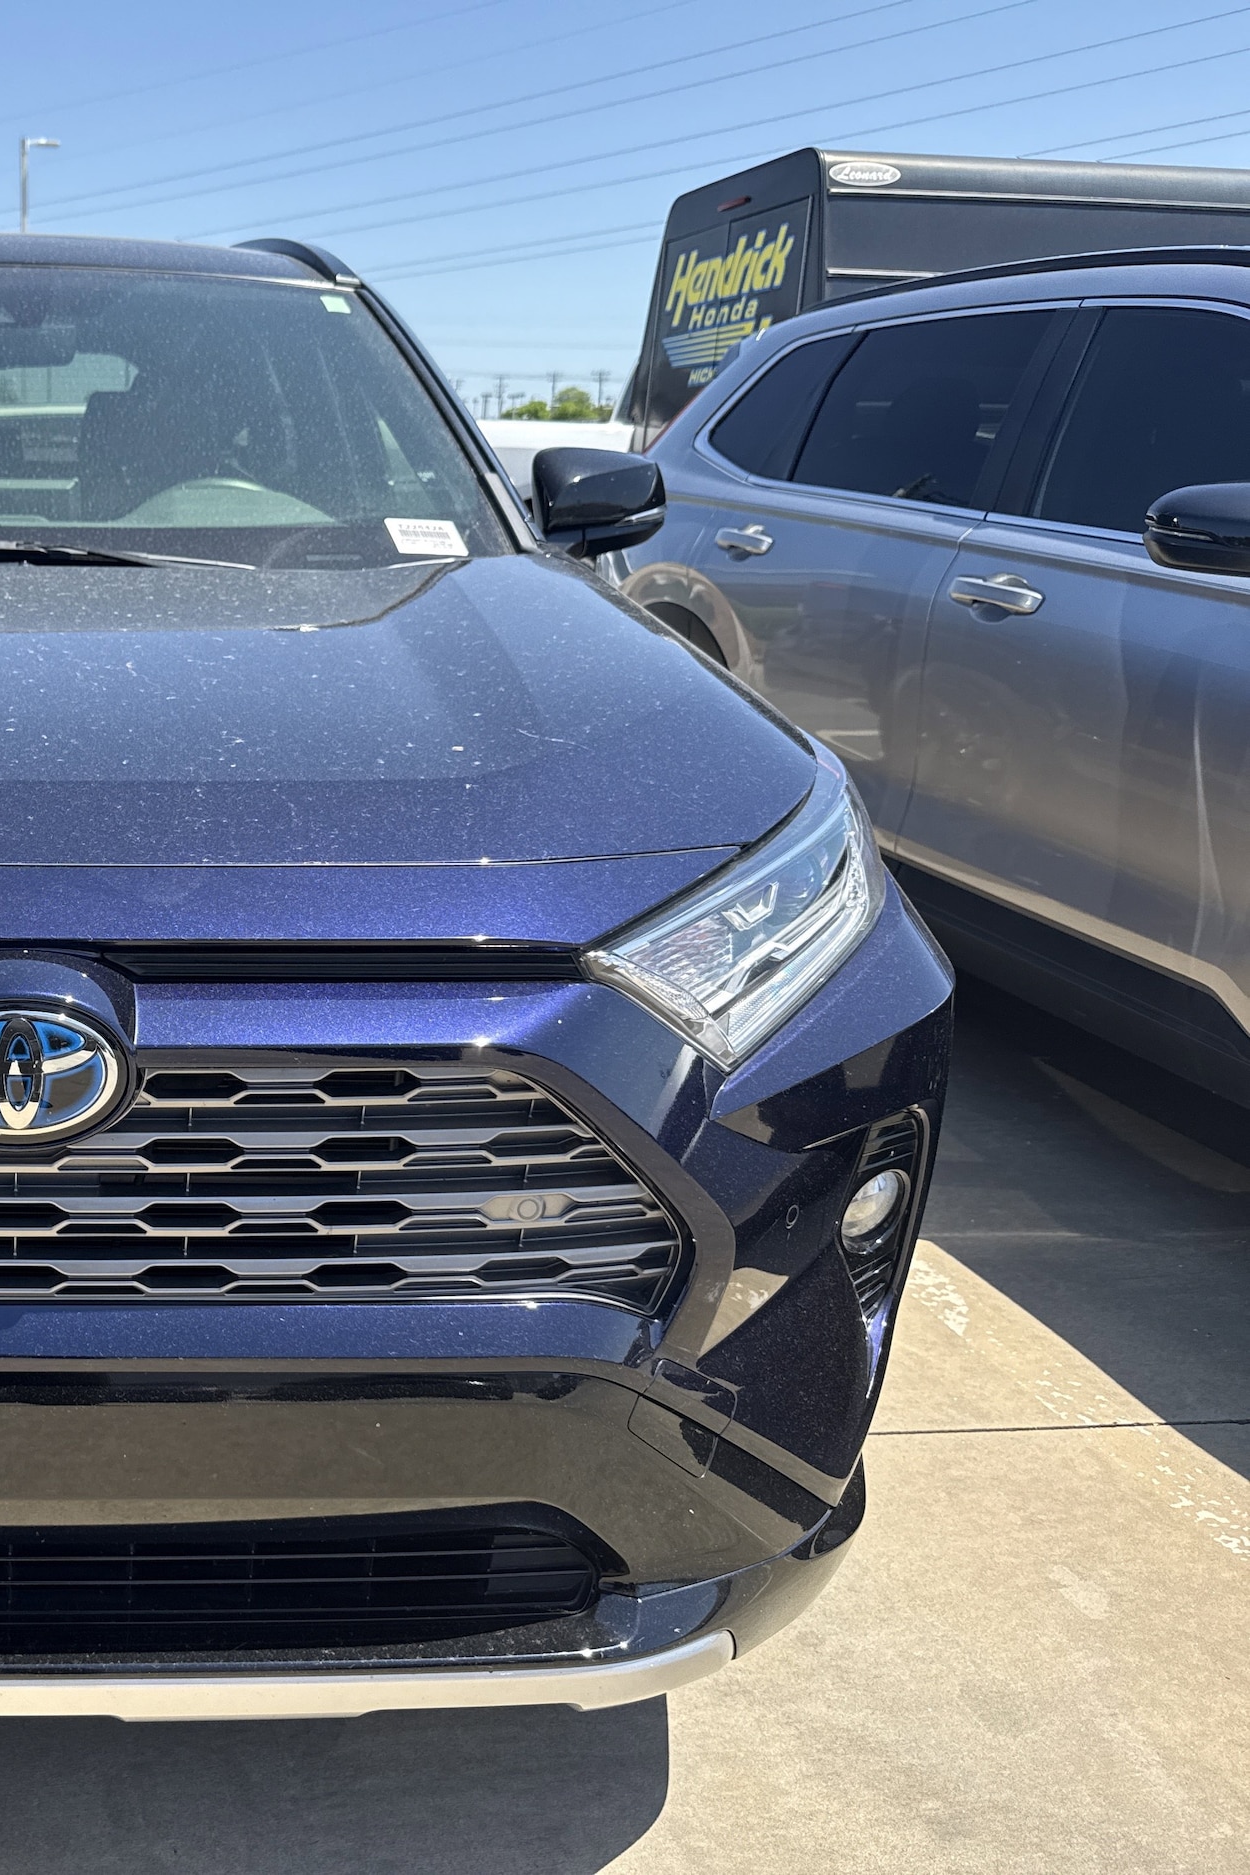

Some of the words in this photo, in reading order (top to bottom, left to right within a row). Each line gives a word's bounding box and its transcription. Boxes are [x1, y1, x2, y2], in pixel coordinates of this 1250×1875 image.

[836, 165, 892, 181] Leonard
[664, 223, 795, 328] Hendrick
[687, 296, 759, 332] Honda
